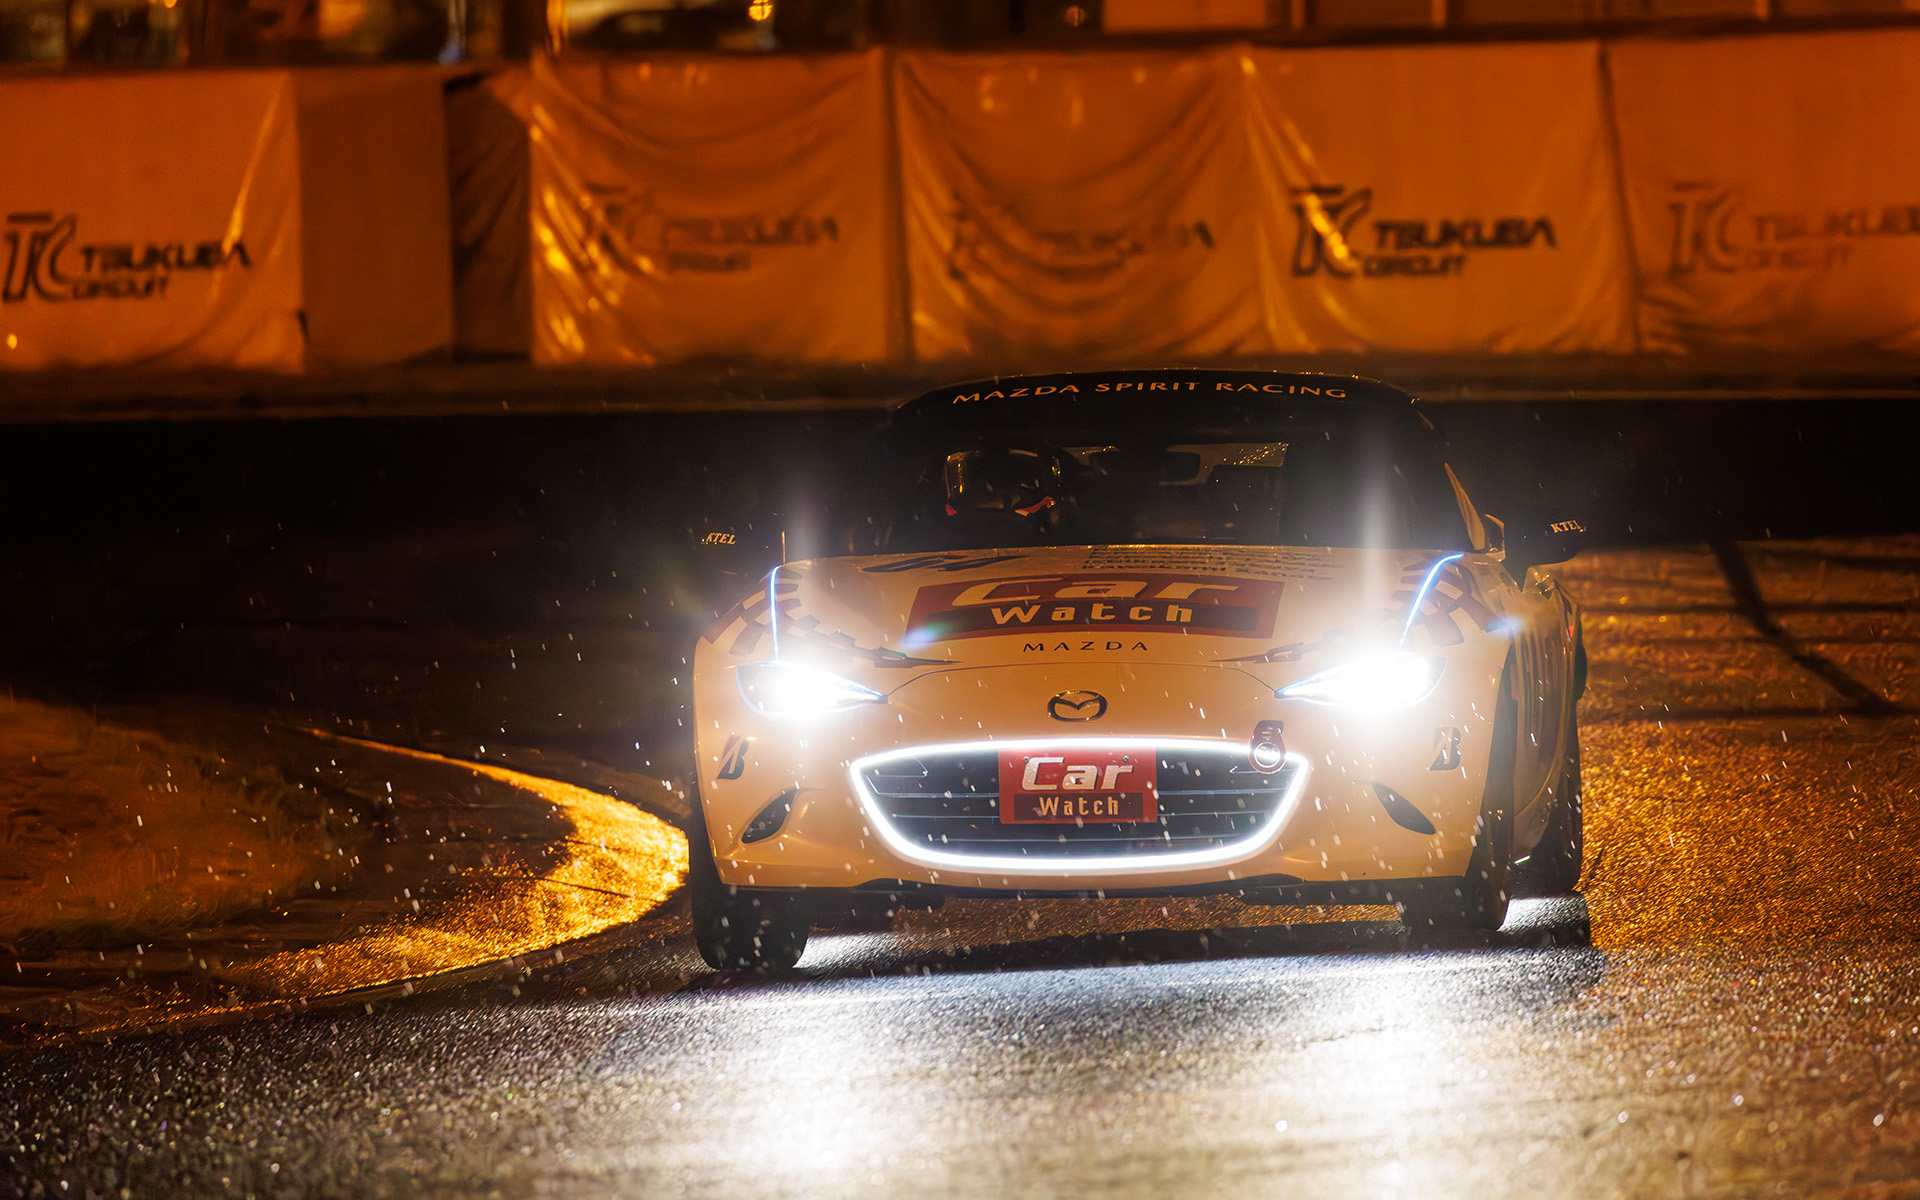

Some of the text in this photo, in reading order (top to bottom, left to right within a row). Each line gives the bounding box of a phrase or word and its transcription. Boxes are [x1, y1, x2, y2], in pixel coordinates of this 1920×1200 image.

[952, 380, 1347, 404] MAZDA SPIRIT RACING
[1550, 520, 1581, 533] KTEL
[705, 532, 736, 545] KTEL
[951, 577, 1239, 607] Car
[1022, 640, 1149, 653] MAZDA
[1021, 757, 1135, 791] Car
[1038, 796, 1120, 816] Watch
